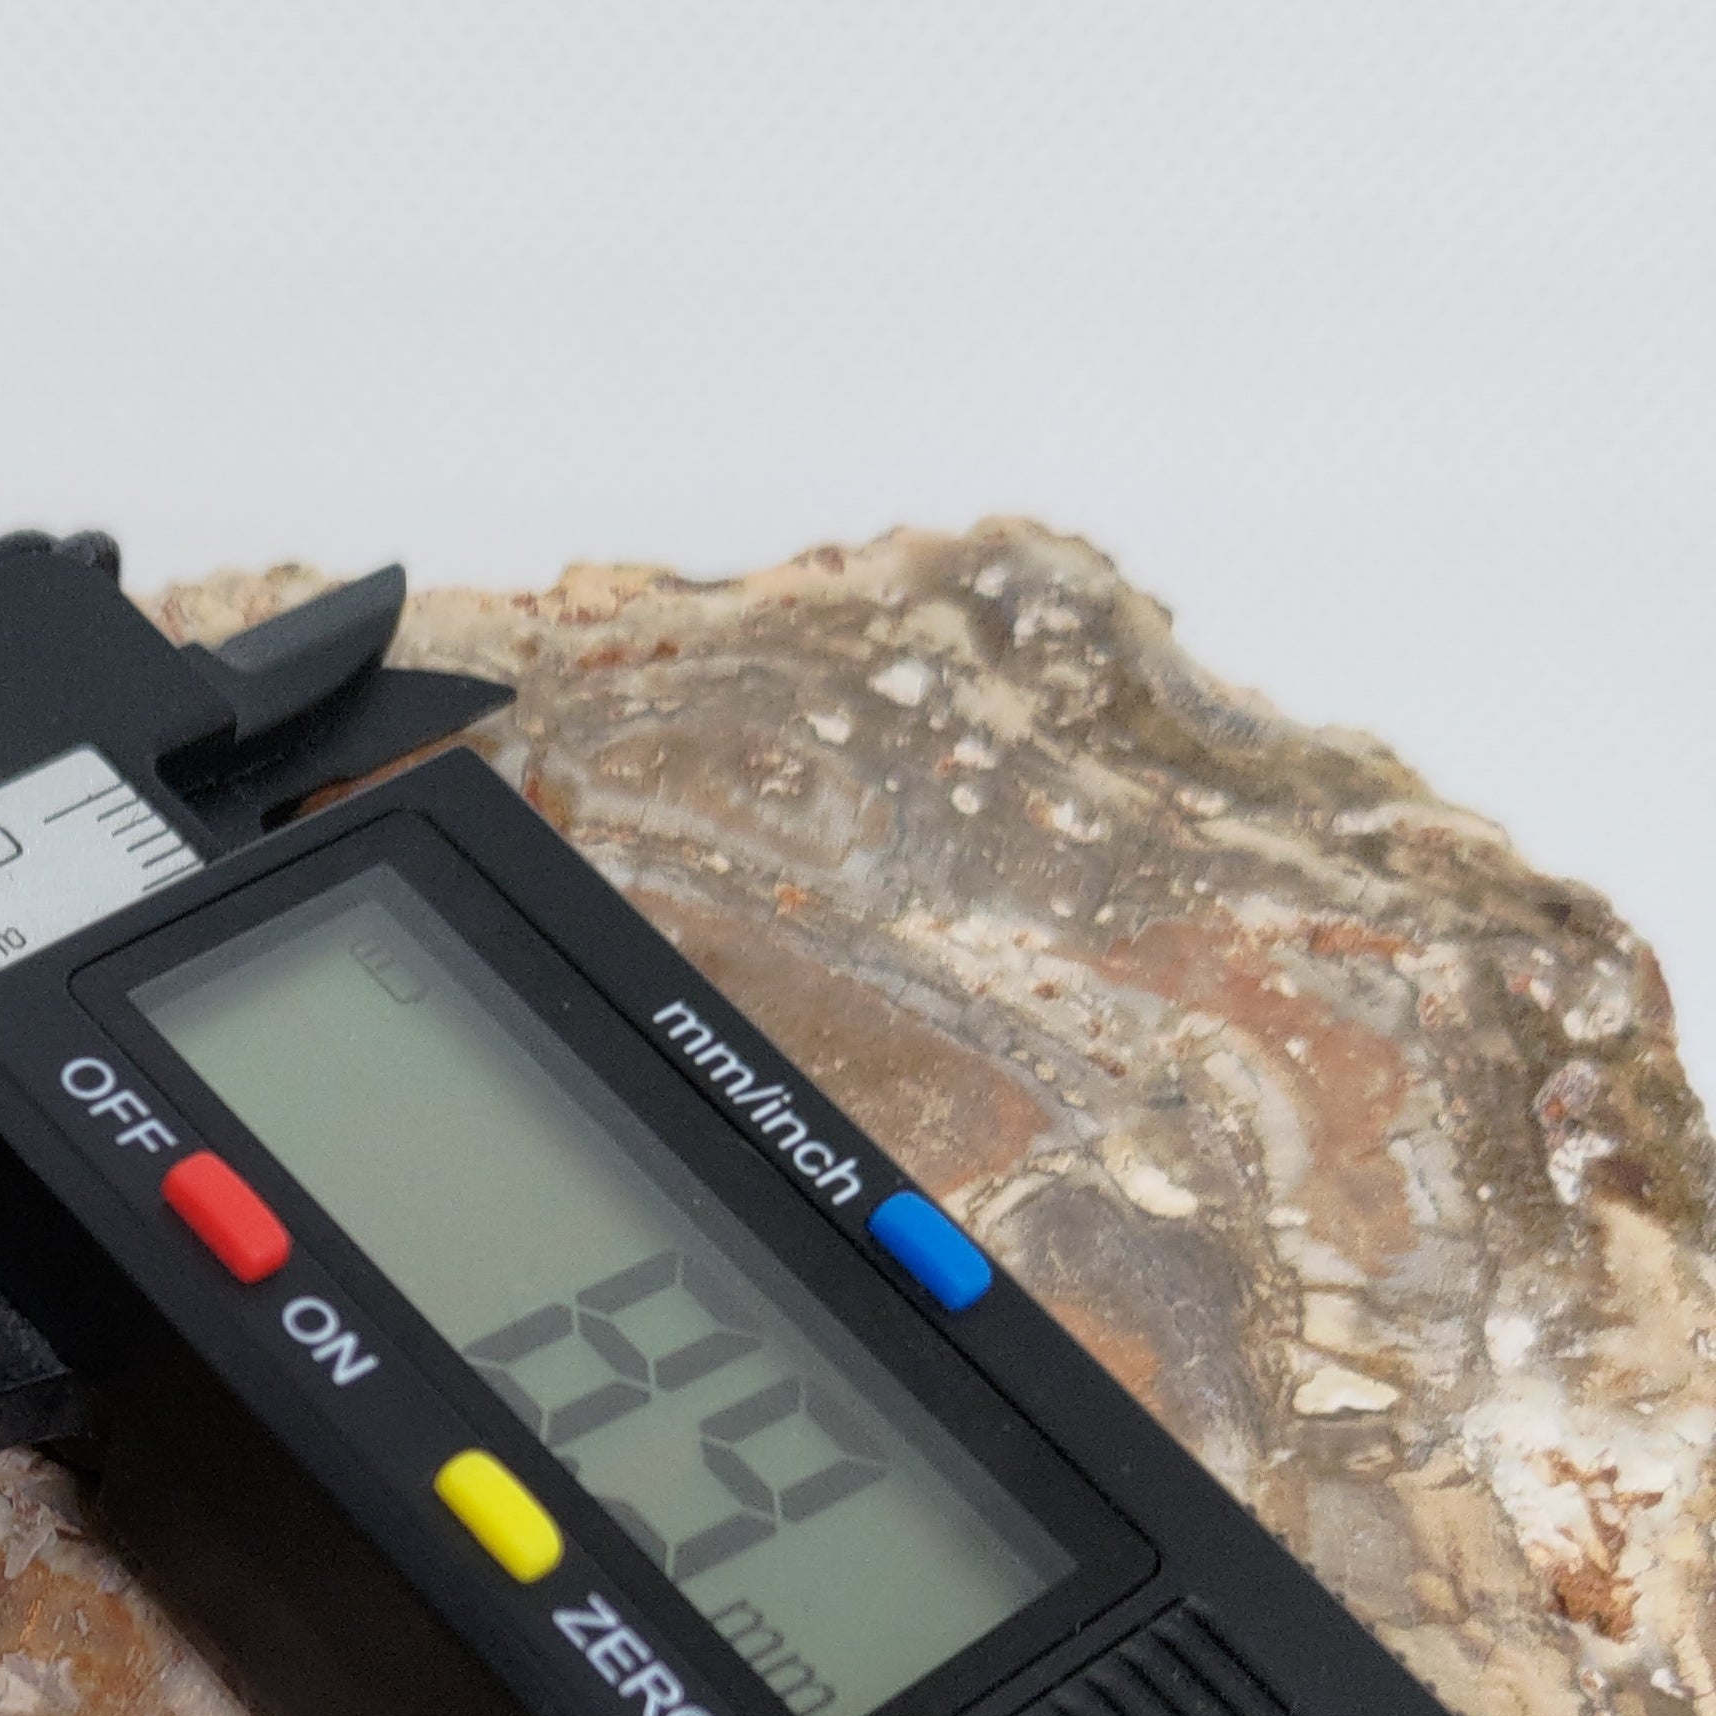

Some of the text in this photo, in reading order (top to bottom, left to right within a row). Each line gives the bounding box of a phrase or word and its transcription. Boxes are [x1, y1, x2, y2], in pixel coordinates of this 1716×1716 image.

[60, 1056, 178, 1154] OFF
[652, 1000, 863, 1206] mm/inch
[281, 1296, 380, 1386] ON
